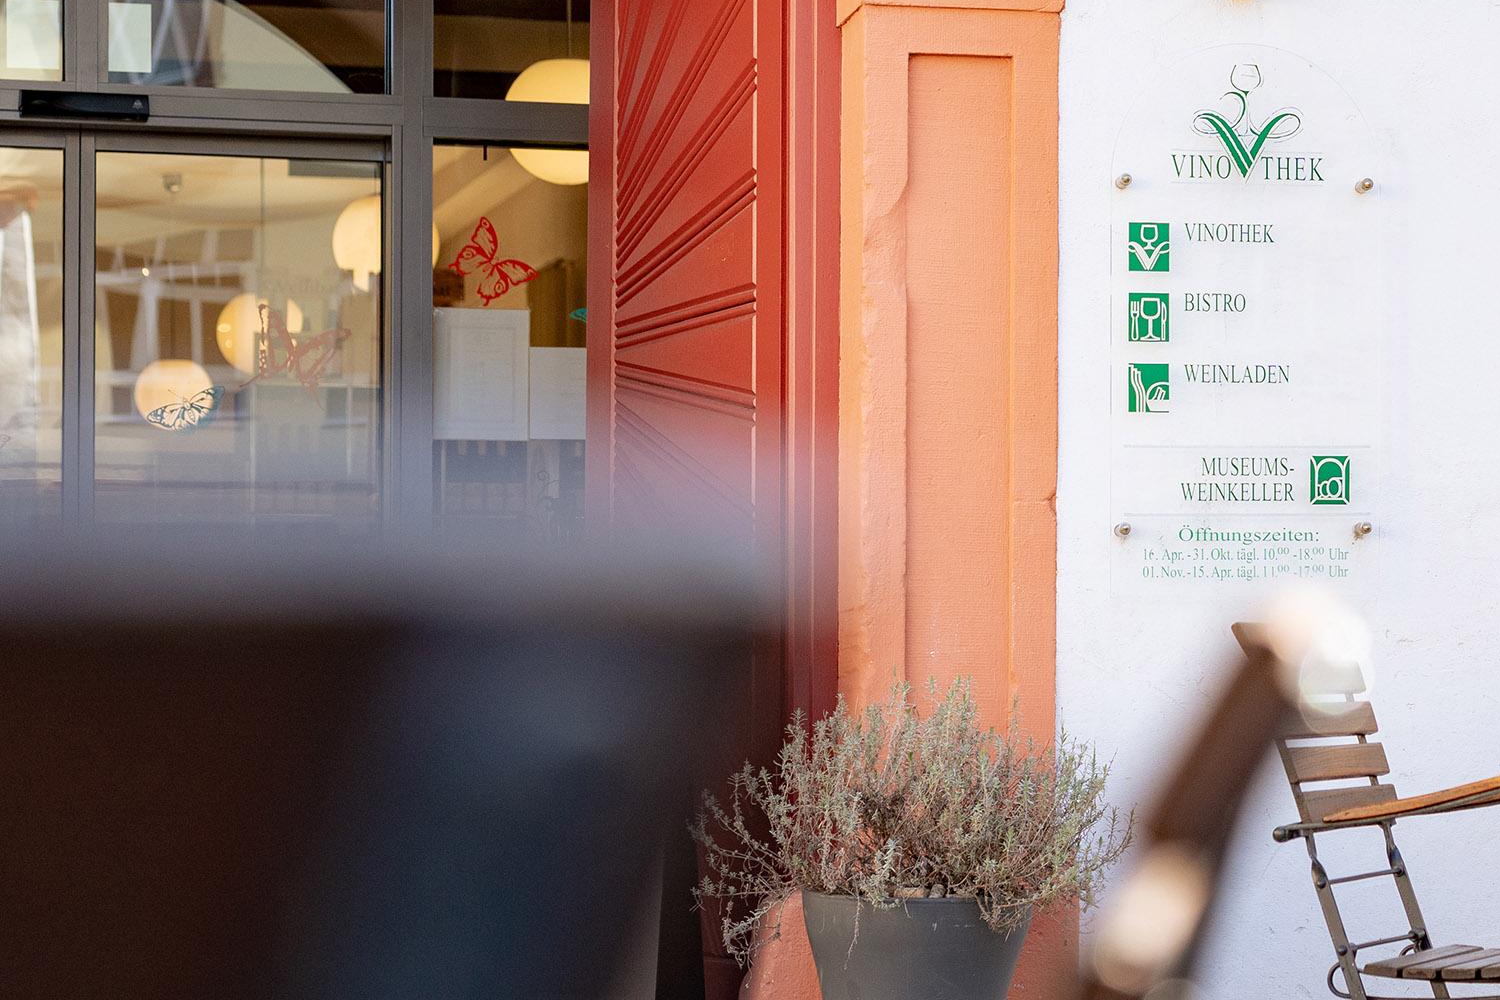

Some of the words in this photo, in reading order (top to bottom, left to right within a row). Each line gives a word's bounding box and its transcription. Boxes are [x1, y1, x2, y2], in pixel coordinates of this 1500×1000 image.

[1184, 222, 1275, 244] VINOTHEK
[1184, 292, 1246, 313] BISTRO
[1184, 364, 1290, 384] WEINLADEN
[1201, 457, 1295, 477] MUSEUMS-
[1180, 482, 1295, 502] WEINKELLER
[1177, 524, 1319, 546] Öffnungszeiten:
[1210, 547, 1234, 561] Okt.
[1236, 547, 1260, 564] tägl.
[1328, 547, 1350, 561] Uhr
[1142, 565, 1159, 579] 01.
[1210, 565, 1234, 581] Apr.
[1236, 565, 1260, 582] tägl.
[1328, 565, 1350, 579] Uhr
